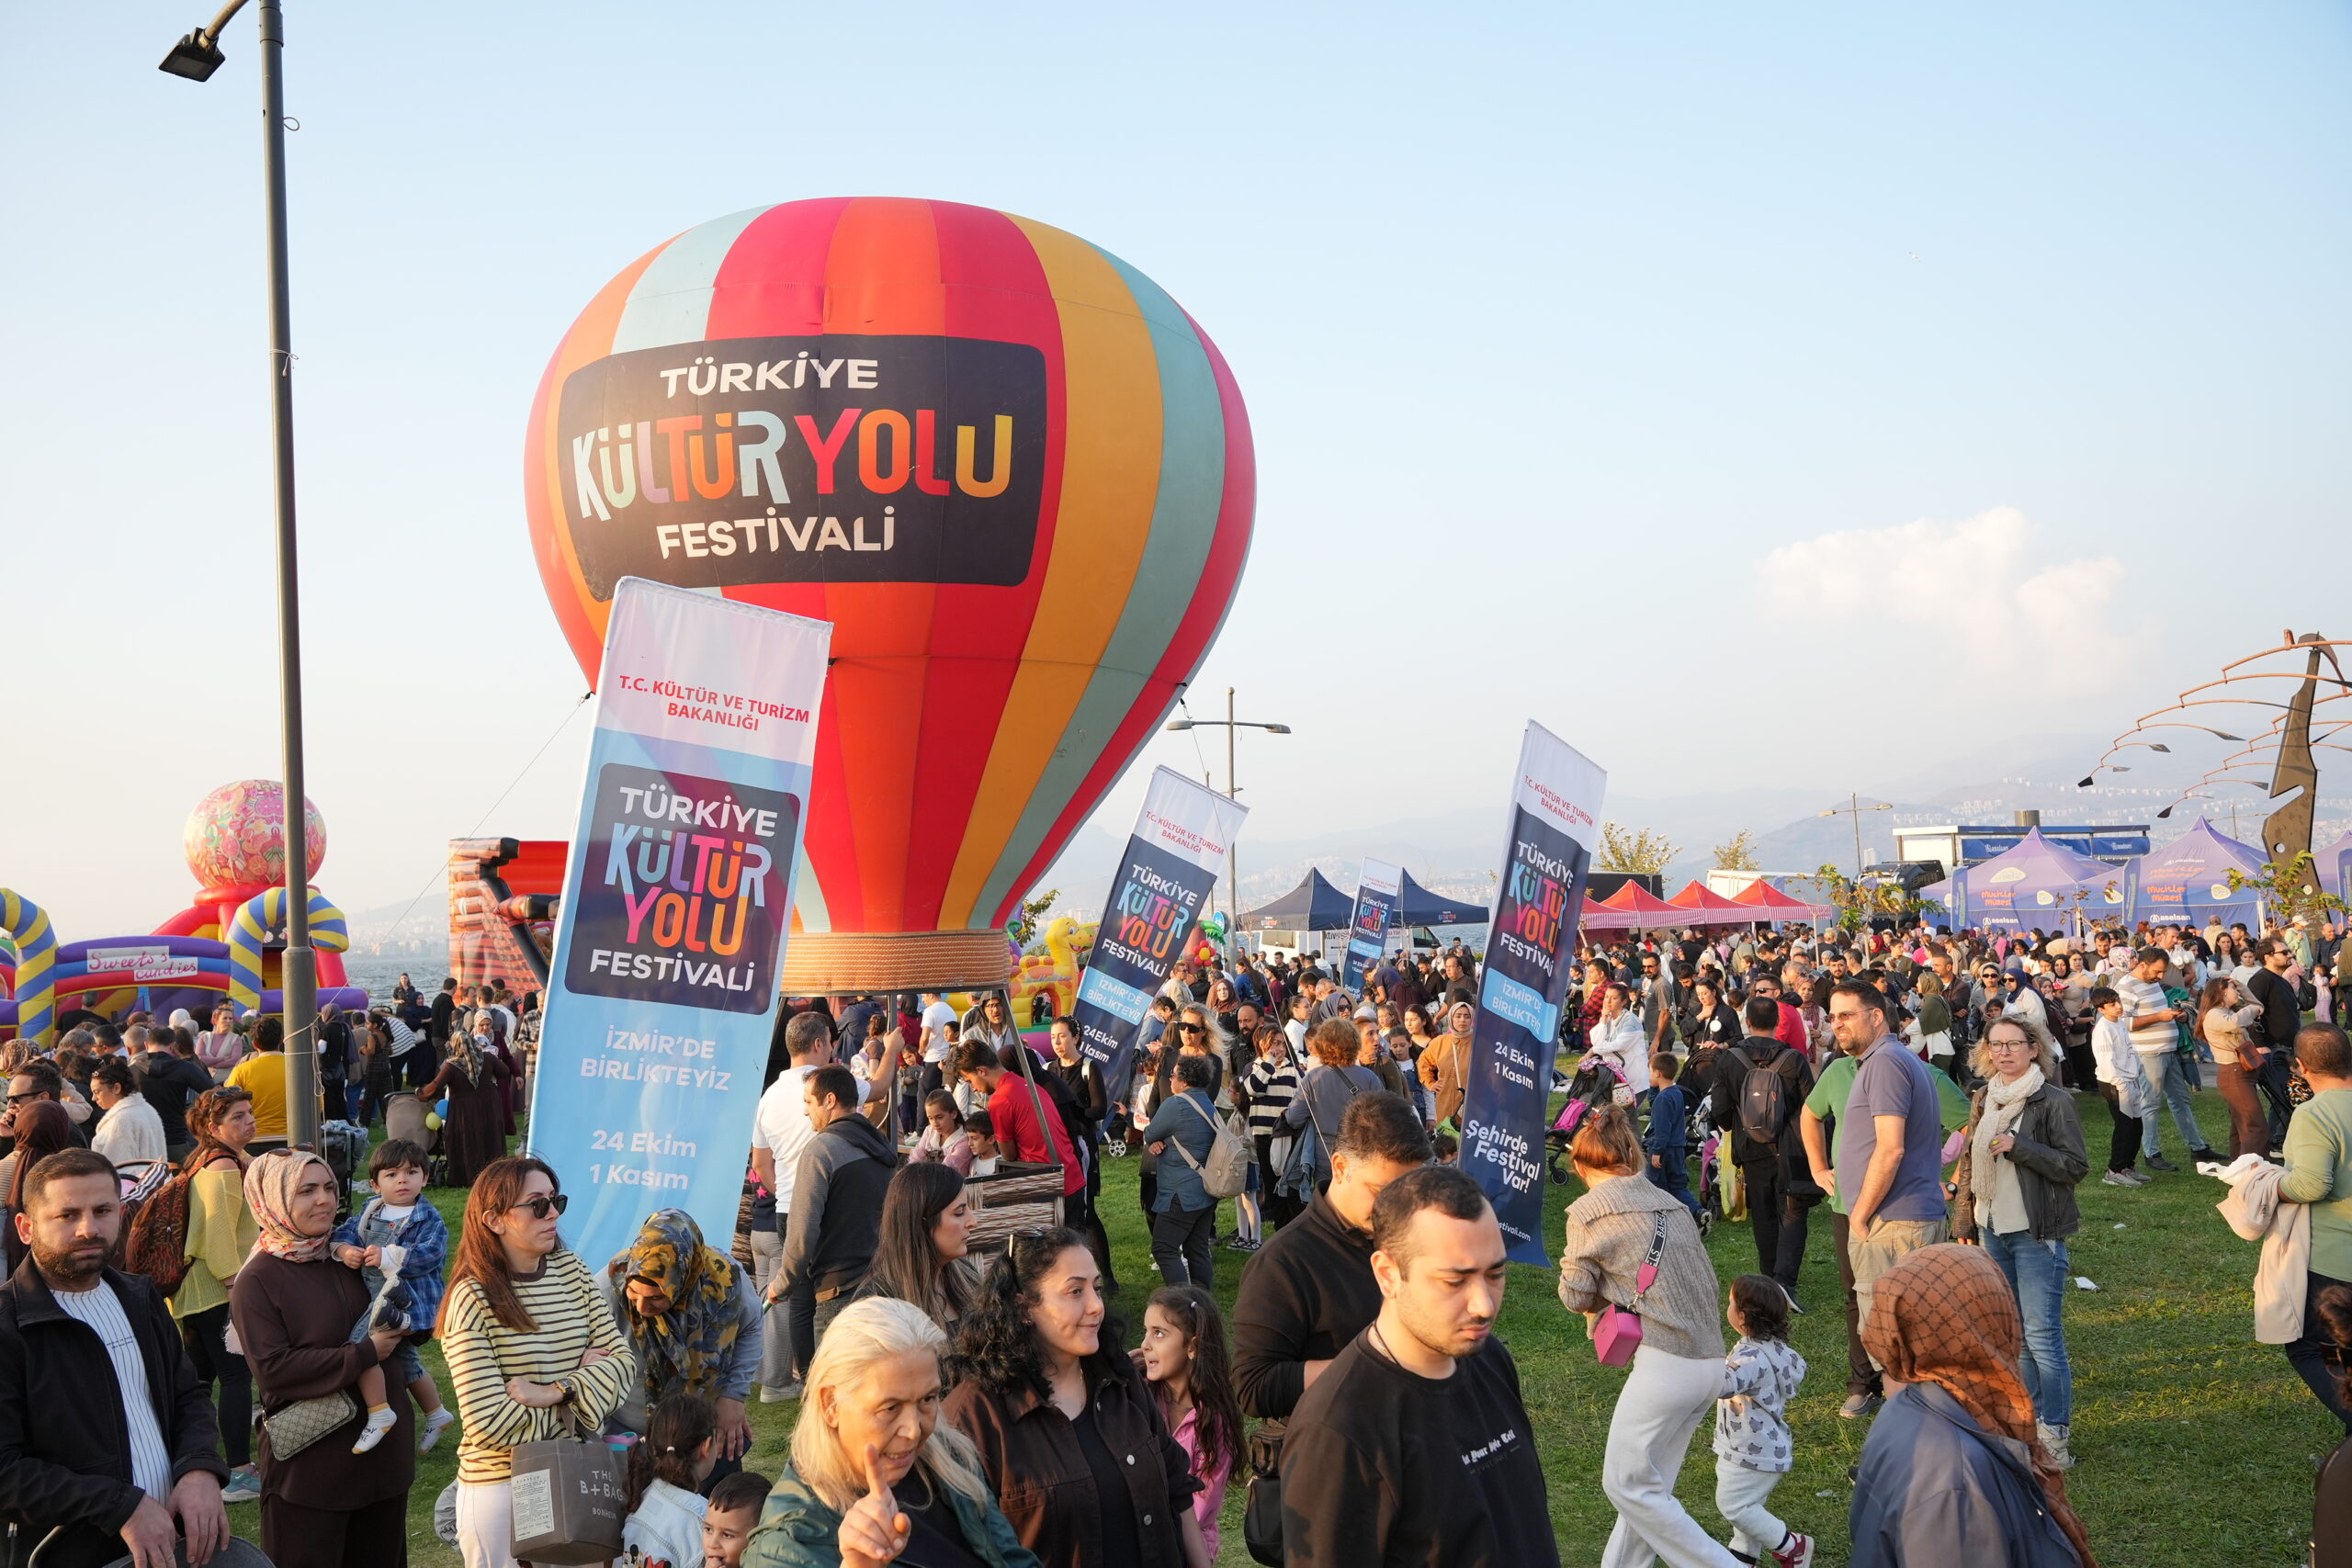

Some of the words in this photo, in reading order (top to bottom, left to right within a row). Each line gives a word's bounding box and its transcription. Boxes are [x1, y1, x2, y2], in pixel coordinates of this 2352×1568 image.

[660, 351, 878, 399] TÜRKİYE
[572, 410, 791, 522] KÜLTÜR
[793, 408, 1012, 499] YOLU
[655, 505, 895, 559] FESTİVALİ
[619, 675, 648, 693] T.C.
[652, 681, 718, 705] KÜLTÜR
[723, 694, 743, 710] VE
[748, 698, 809, 724] TURİZM
[667, 703, 760, 731] BAKANLIĞI
[620, 783, 778, 838] TÜRKİYE
[1534, 783, 1561, 805] KÜLTÜR
[1562, 799, 1571, 811] VE
[1572, 806, 1593, 828] TURİZM
[1541, 797, 1577, 825] BAKANLIĞI
[1158, 818, 1186, 837] KÜLTÜR
[1188, 832, 1197, 840] VE
[1198, 838, 1225, 855] TURİZM
[1161, 829, 1202, 853] BAKANLIĞI
[605, 823, 772, 908] KÜLTÜR
[1517, 840, 1574, 889] TÜRKİYE
[1132, 864, 1198, 906] TÜRKİYE
[1117, 880, 1189, 939] KÜLTÜR
[1360, 903, 1387, 923] KÜLTÜR
[1362, 897, 1388, 909] TÜRKİYE
[624, 886, 749, 956] YOLU
[1118, 915, 1174, 958] YOLU
[1356, 926, 1382, 939] FESTİVALİ
[1361, 916, 1382, 931] YOLU
[89, 951, 154, 970] Sweets
[136, 962, 197, 979] candies
[589, 949, 755, 992] FESTİVALİ
[1102, 938, 1168, 977] FESTİVALİ
[1087, 988, 1141, 1021] BİRLİKTEYİZ
[1084, 1043, 1110, 1063] Kasım
[1495, 1042, 1508, 1057] 24
[1510, 1048, 1534, 1071] Ekim
[581, 1055, 731, 1090] BİRLİKTEYİZ
[1494, 1062, 1500, 1074] 1
[1502, 1064, 1533, 1090] Kasım
[591, 1130, 625, 1151] 24
[631, 1132, 696, 1157] Ekim
[1465, 1120, 1528, 1155] Şehirde
[590, 1164, 600, 1183] 1
[606, 1165, 688, 1190] Kasım
[1474, 1139, 1540, 1181] Festival
[1502, 1168, 1530, 1194] Var!
[1498, 1222, 1531, 1242] stivali.com
[592, 1471, 613, 1482] THE
